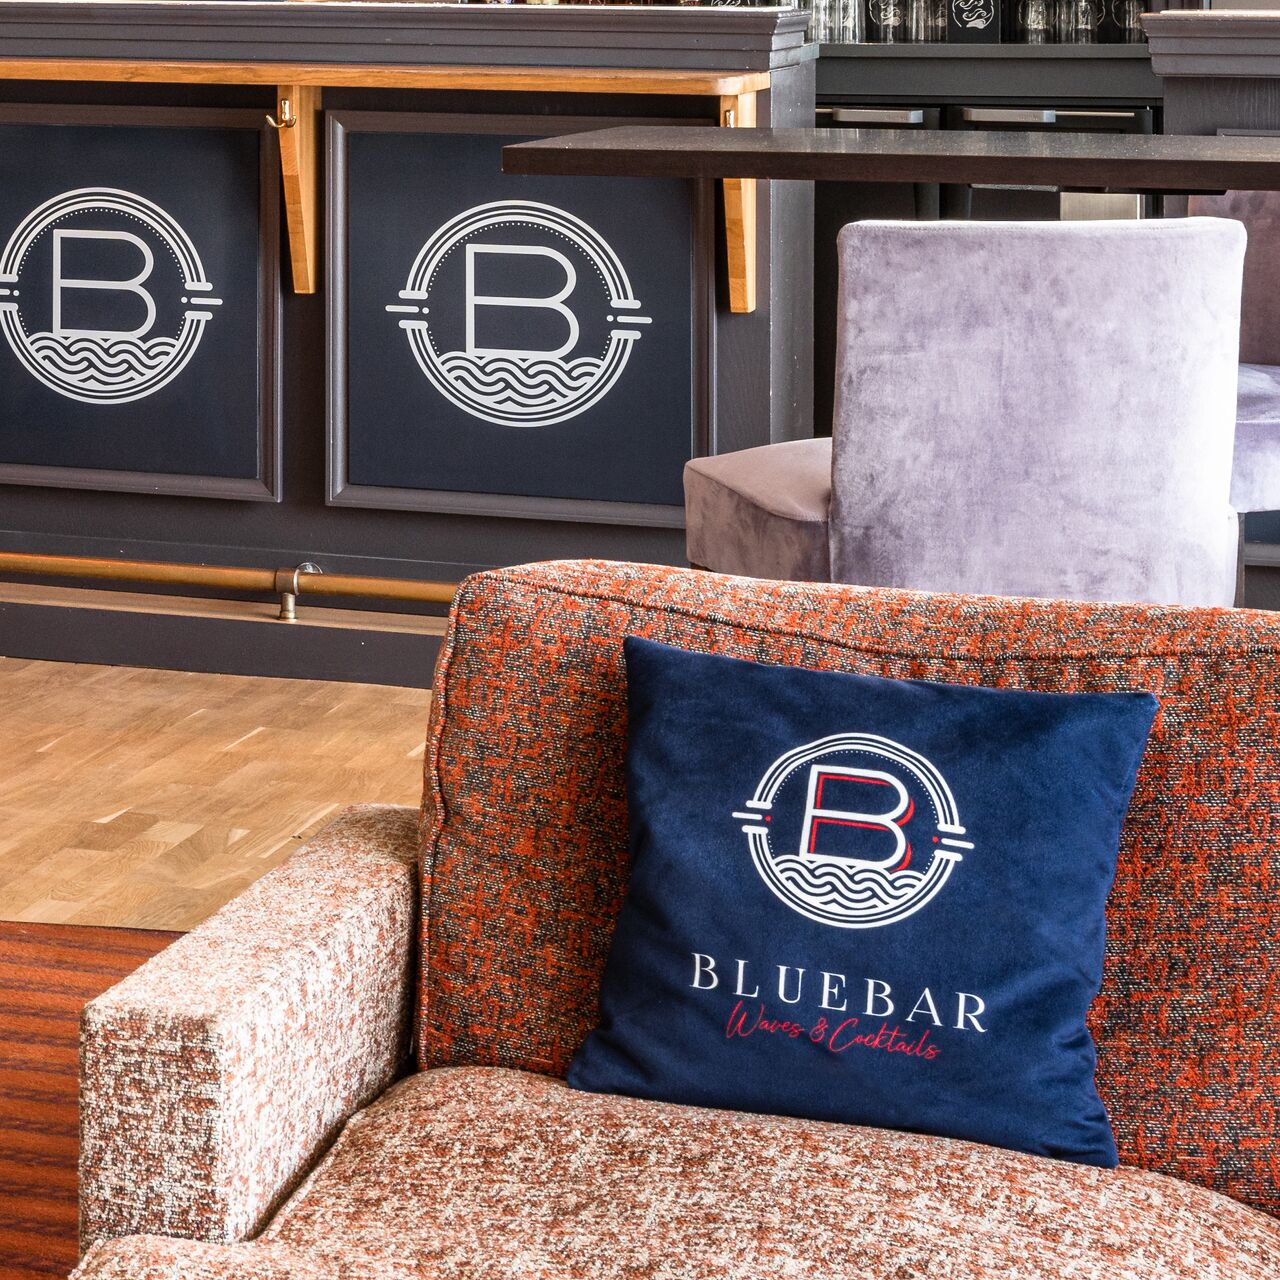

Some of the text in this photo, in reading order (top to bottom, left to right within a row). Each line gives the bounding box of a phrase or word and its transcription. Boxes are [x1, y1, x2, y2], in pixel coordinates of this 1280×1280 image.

[800, 764, 915, 873] B
[689, 952, 988, 1033] BLUEBAR
[725, 1000, 942, 1061] Waves & Cocktails
